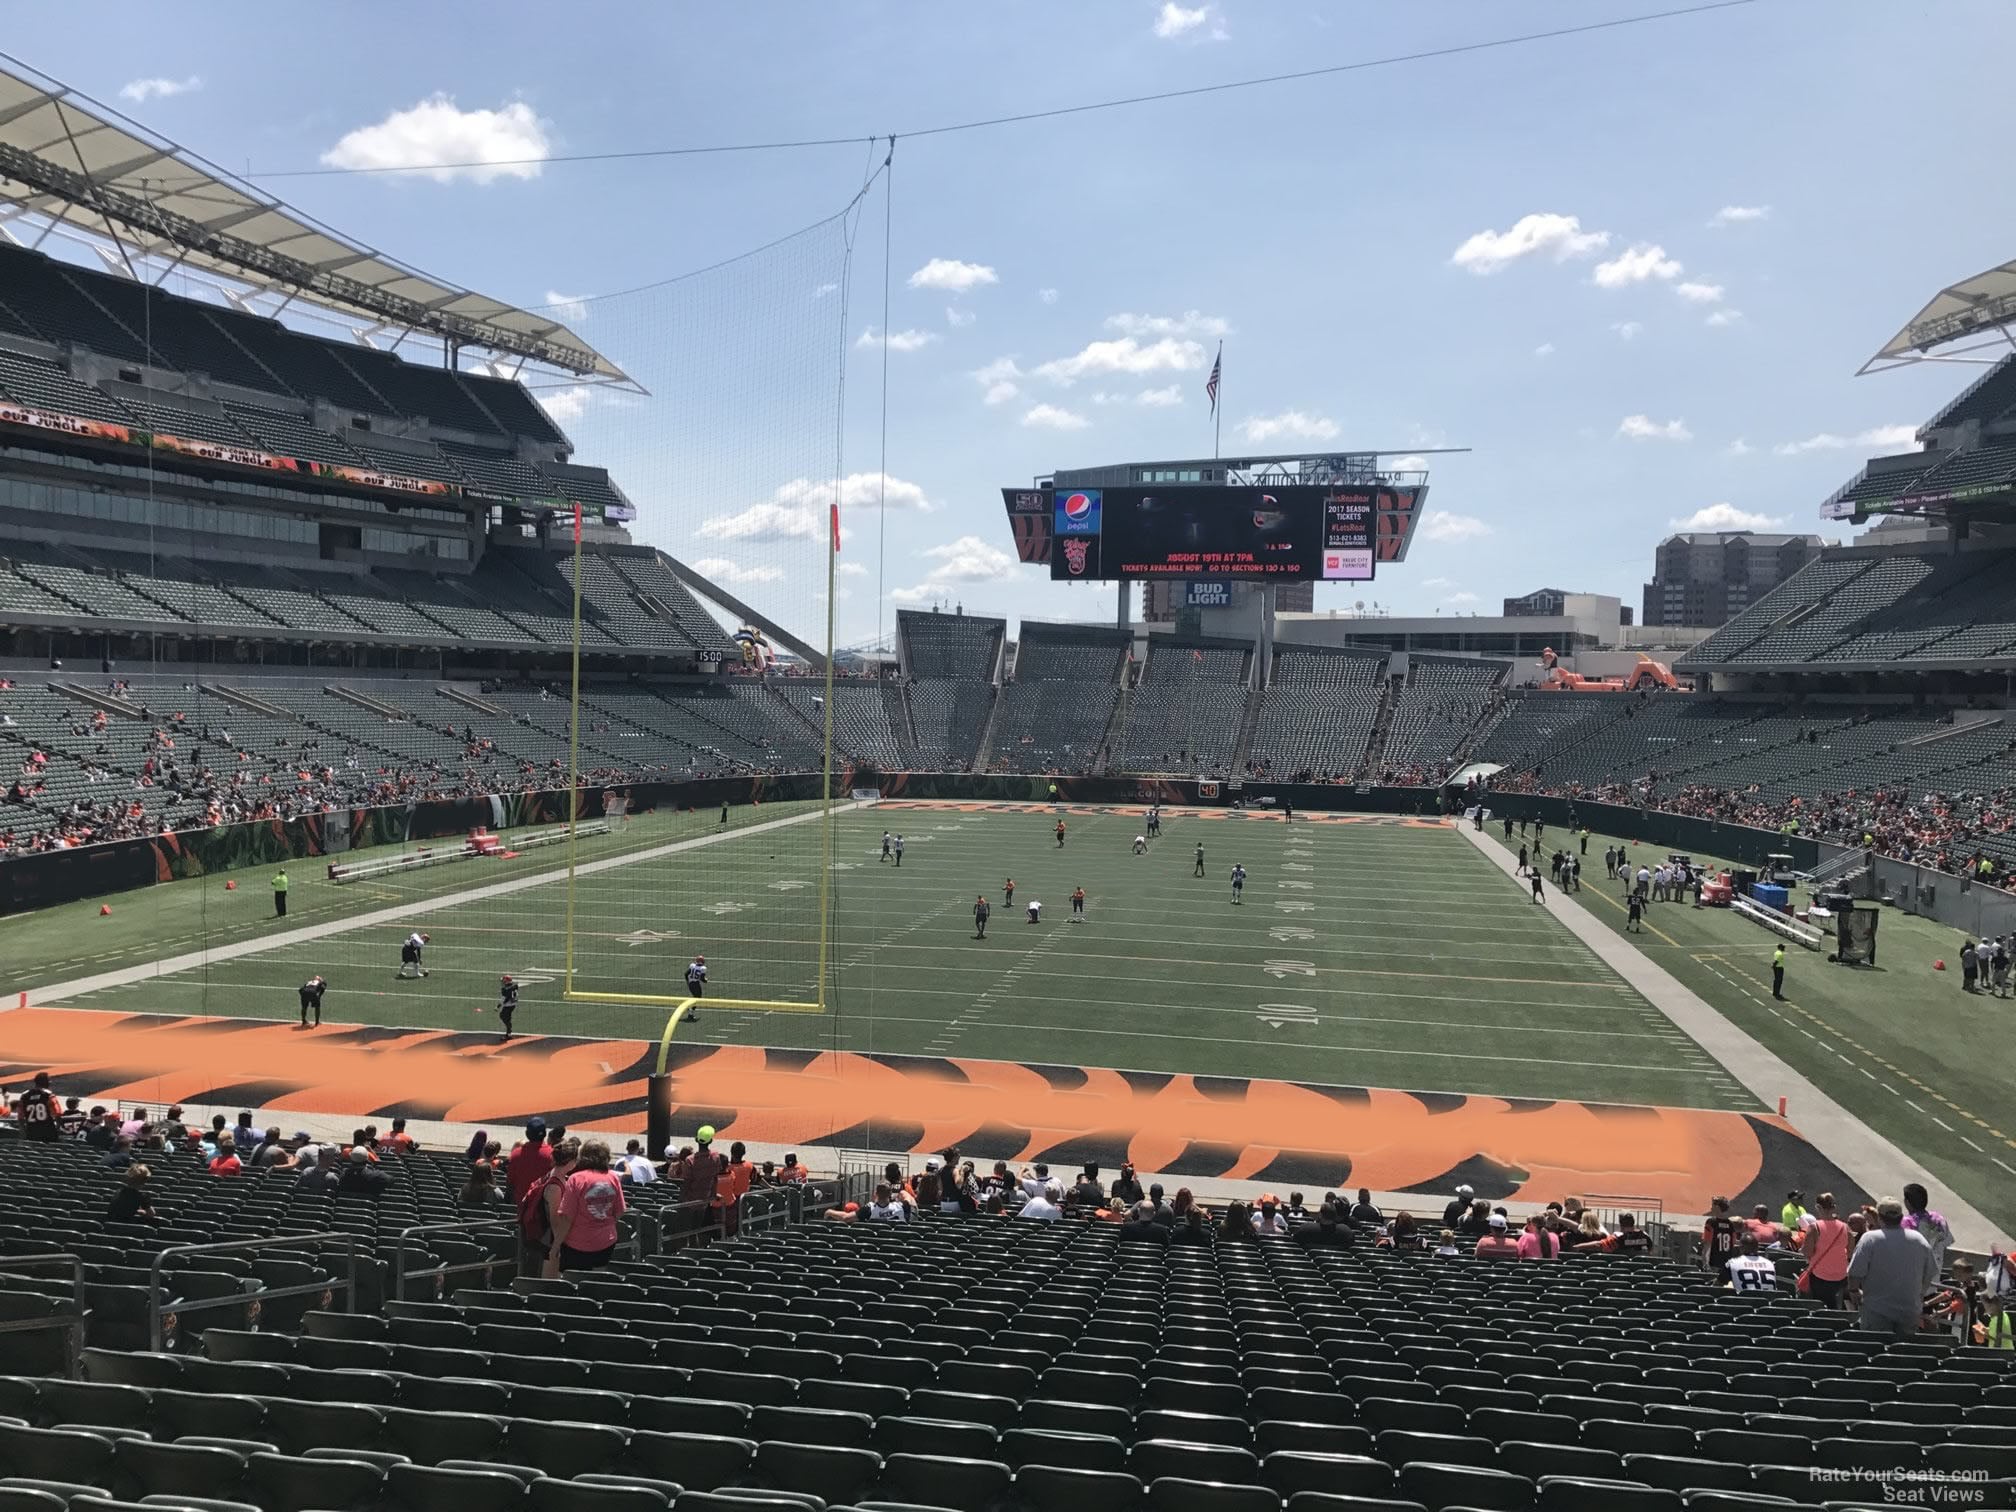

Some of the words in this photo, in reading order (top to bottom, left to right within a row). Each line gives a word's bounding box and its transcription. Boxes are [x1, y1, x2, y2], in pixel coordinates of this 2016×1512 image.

[2, 411, 29, 422] OUR
[37, 417, 89, 434] JUNGLE
[200, 448, 222, 458] OUR
[228, 453, 273, 467] JUNGLE
[364, 476, 385, 486] OUR
[389, 480, 429, 492] JUNGLE
[1328, 505, 1345, 513] 2017
[1346, 505, 1370, 513] SEASON
[1067, 522, 1089, 530] pepsi
[1167, 553, 1200, 562] AUGUST
[1202, 553, 1222, 562] 19TH
[1224, 553, 1236, 562] AT
[1237, 553, 1253, 562] 7PM
[1194, 583, 1223, 594] BUD
[1188, 594, 1228, 604] LIGHT
[1201, 786, 1216, 796] 40
[690, 968, 701, 979] 15
[1263, 960, 1316, 976] 20
[1256, 1003, 1319, 1024] 10
[26, 1103, 47, 1122] 28
[1717, 1233, 1730, 1251] 18
[1737, 1270, 1775, 1290] 85
